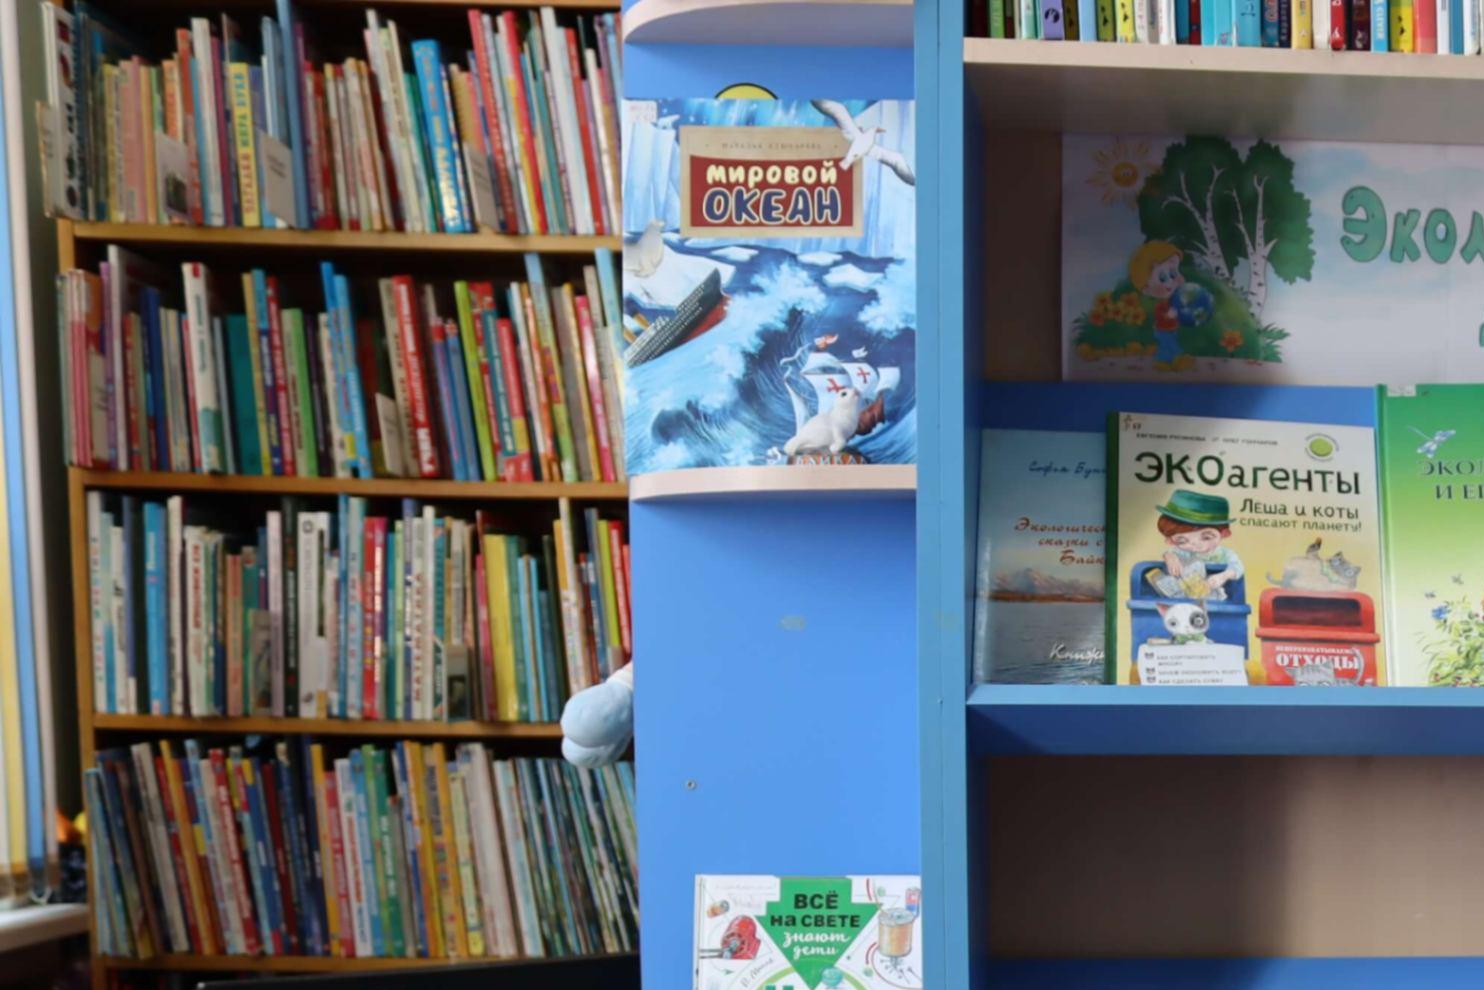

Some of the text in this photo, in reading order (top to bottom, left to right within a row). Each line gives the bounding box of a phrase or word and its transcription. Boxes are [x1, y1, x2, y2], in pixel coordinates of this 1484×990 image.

[703, 187, 841, 225] ОКЕАН
[1436, 484, 1452, 500] И
[1312, 505, 1359, 519] коты
[1239, 516, 1362, 532] спасают планету!
[794, 890, 839, 910] ВСЁ
[801, 914, 861, 927] СВЕТЕ
[783, 931, 851, 947] знают
[793, 943, 839, 959] дети
